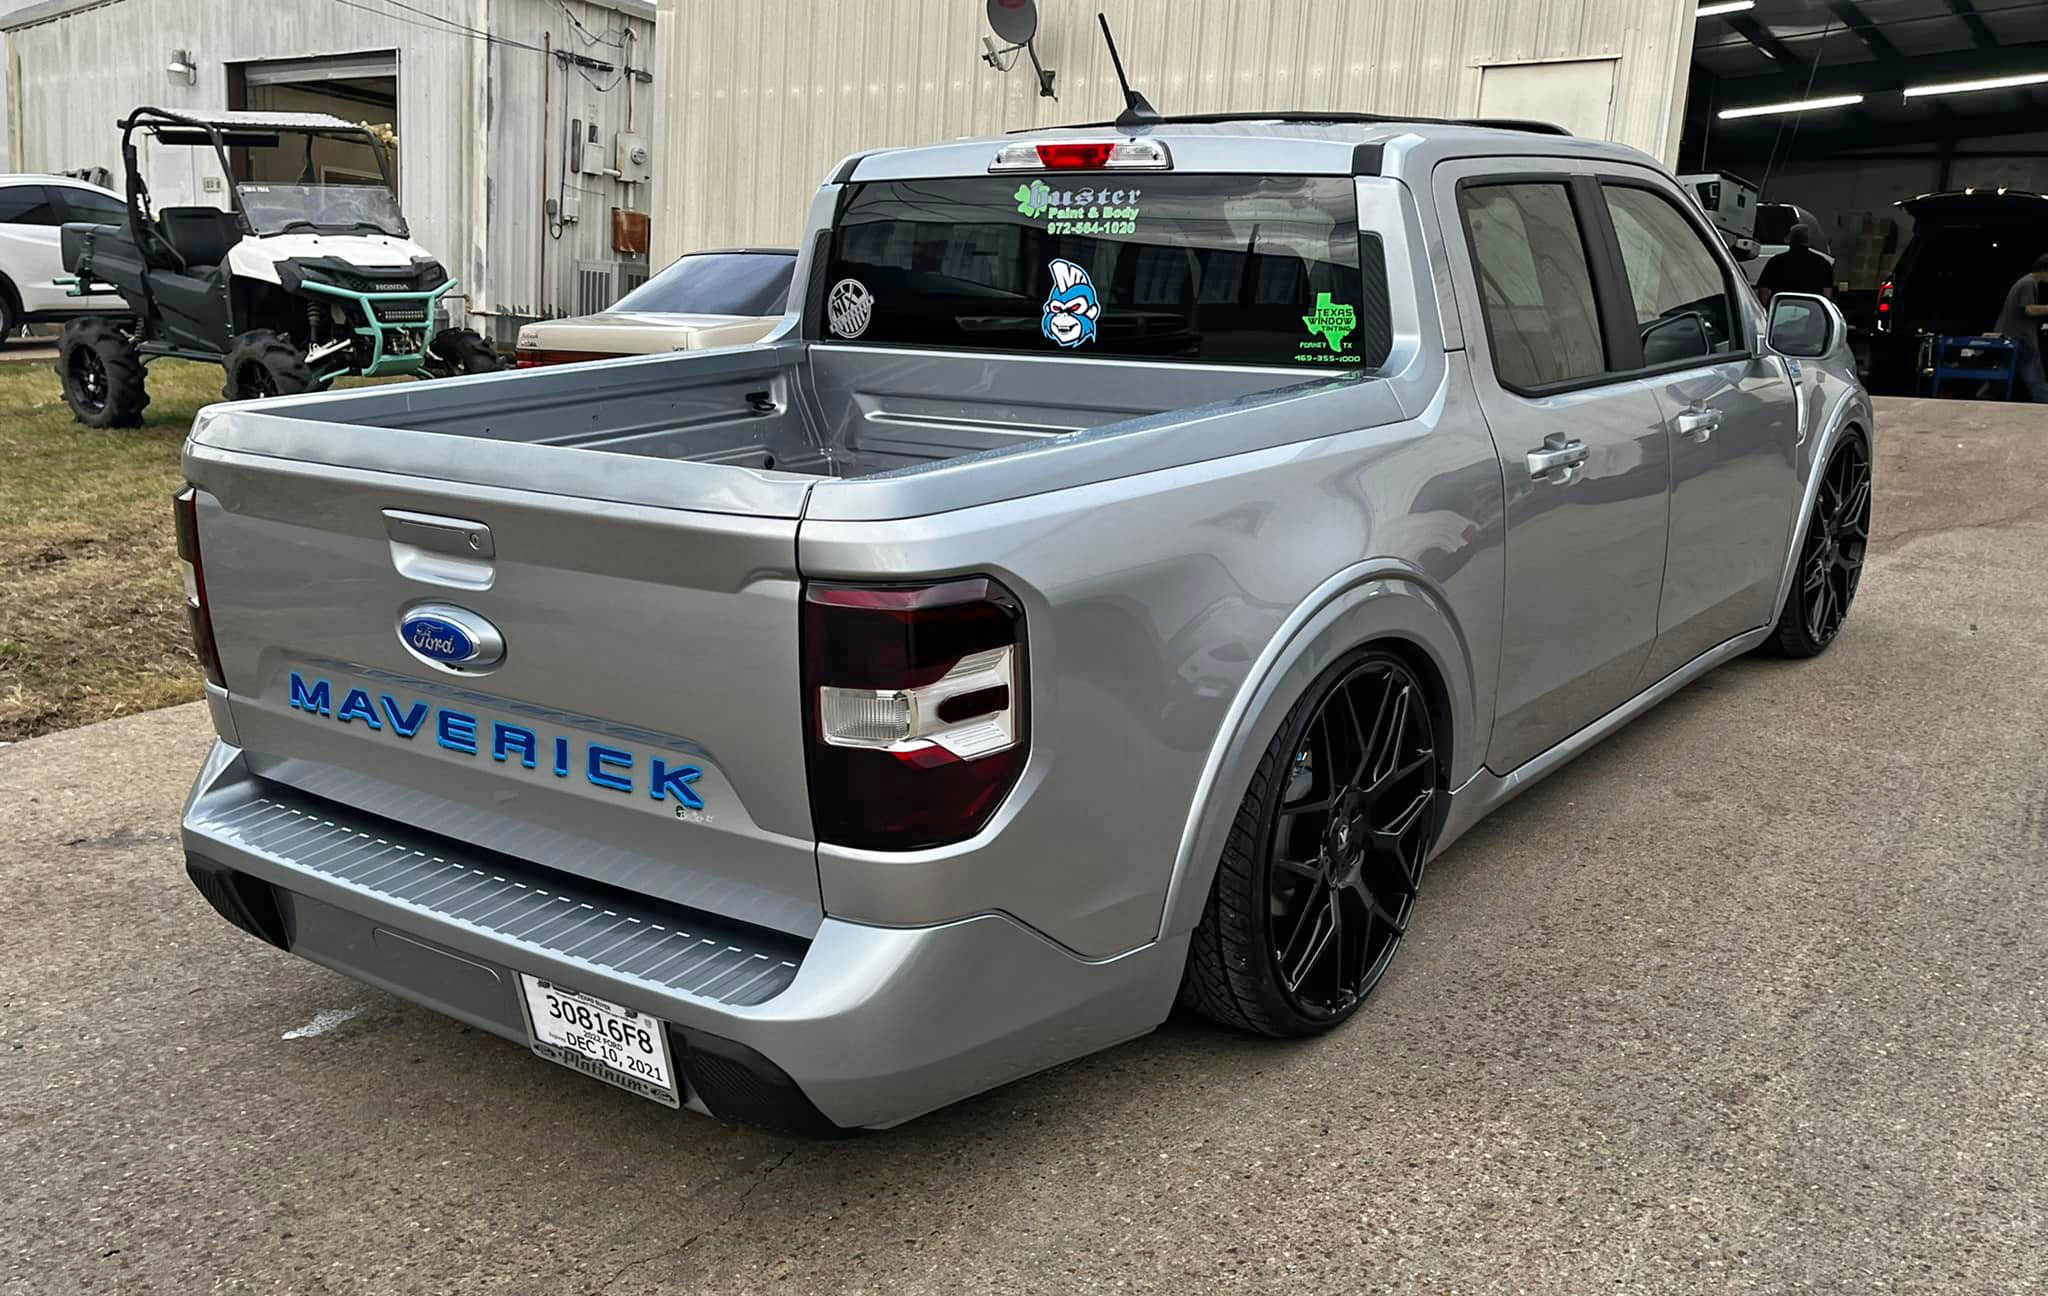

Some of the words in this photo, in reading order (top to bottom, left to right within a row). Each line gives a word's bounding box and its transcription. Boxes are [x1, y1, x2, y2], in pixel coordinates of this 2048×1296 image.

[1048, 207, 1085, 219] Paint
[1088, 206, 1099, 218] &
[1103, 206, 1139, 220] Body
[1047, 222, 1136, 234] 972-564-1020
[1308, 317, 1352, 325] WINDOW
[1317, 308, 1352, 317] TEXAS
[413, 622, 455, 654] Ford
[289, 672, 705, 809] MAVERICK
[546, 995, 653, 1054] 30816F8
[583, 1030, 601, 1043] 2022
[603, 1038, 623, 1051] FORD
[566, 1032, 597, 1054] DEC
[600, 1045, 623, 1067] 10,
[626, 1056, 663, 1082] 2021
[563, 1050, 642, 1092] Platinum
